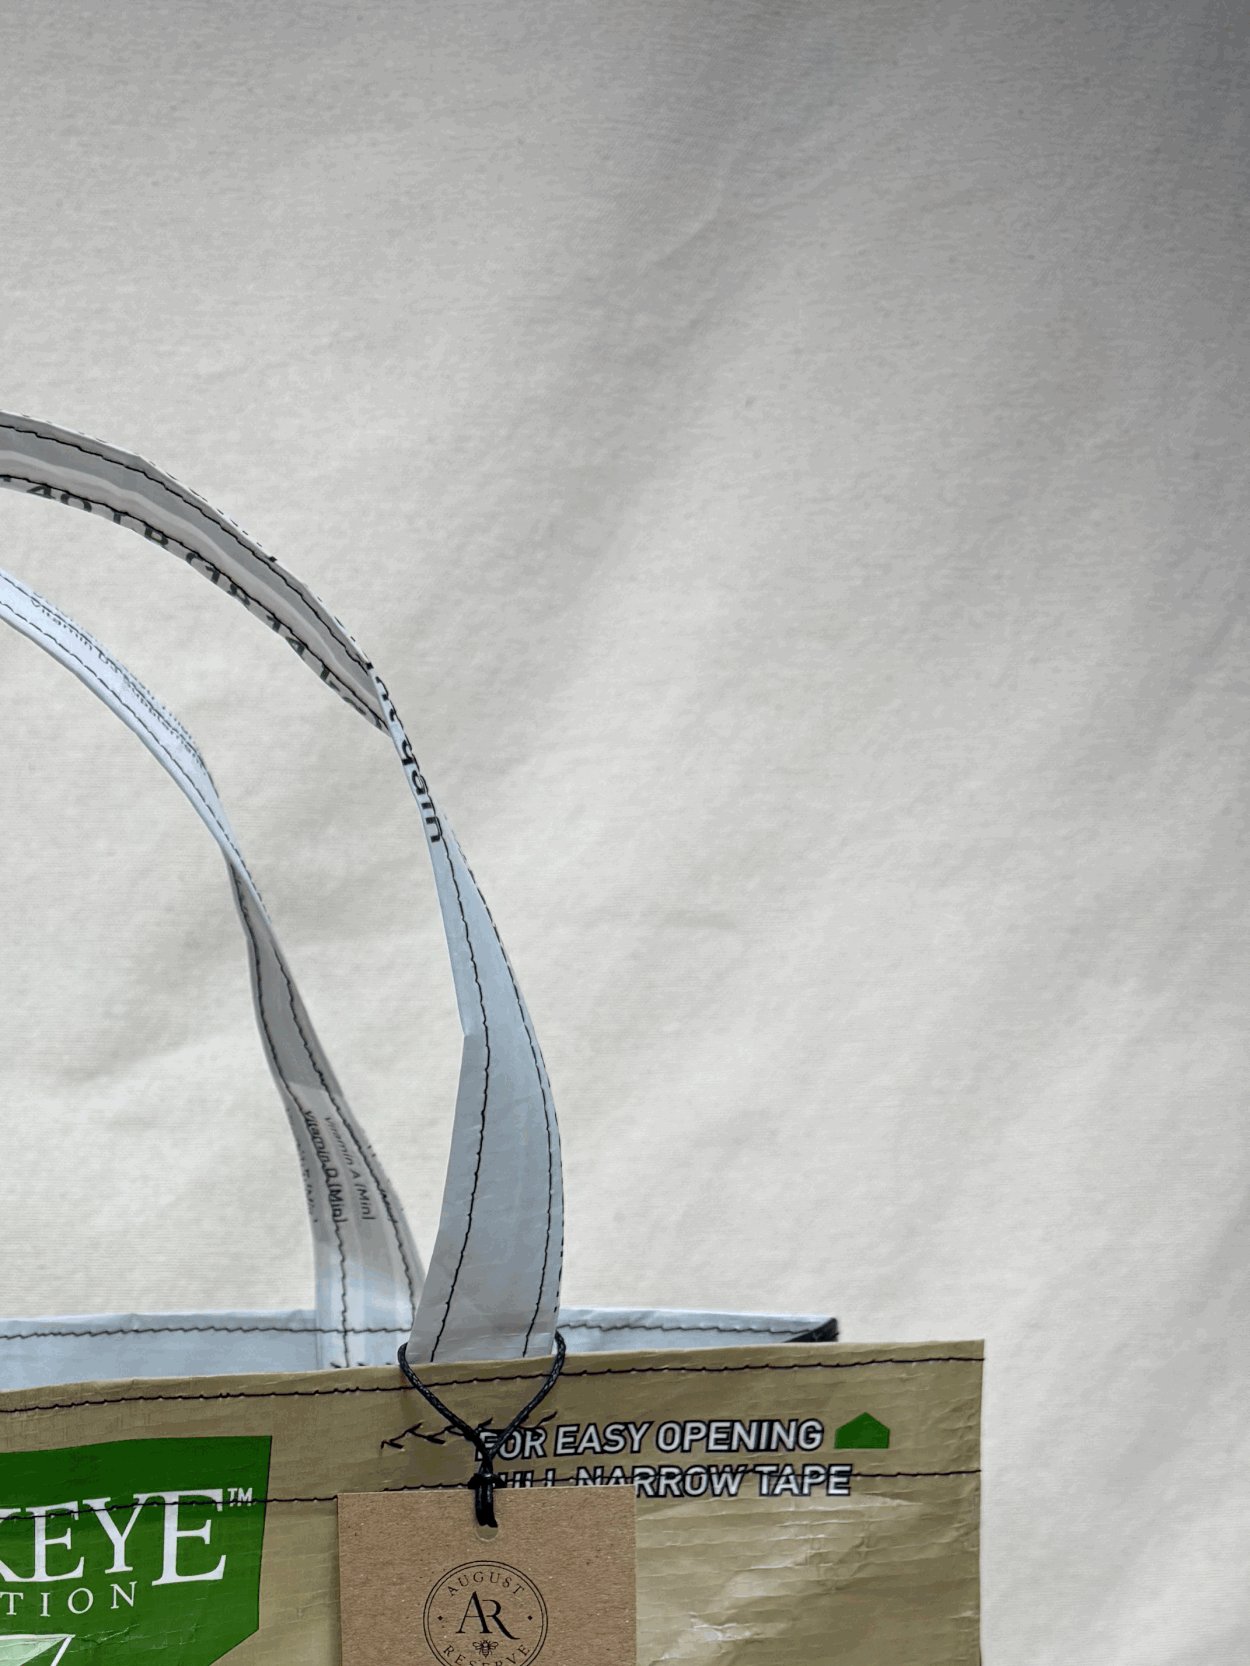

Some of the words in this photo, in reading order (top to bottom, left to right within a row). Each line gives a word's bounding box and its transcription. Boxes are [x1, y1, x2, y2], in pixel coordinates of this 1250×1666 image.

[554, 1421, 654, 1457] EASY
[656, 1418, 825, 1453] OPENING
[754, 1462, 852, 1497] TAPE
[447, 1571, 525, 1597] AUGUST
[455, 1591, 521, 1640] AR
